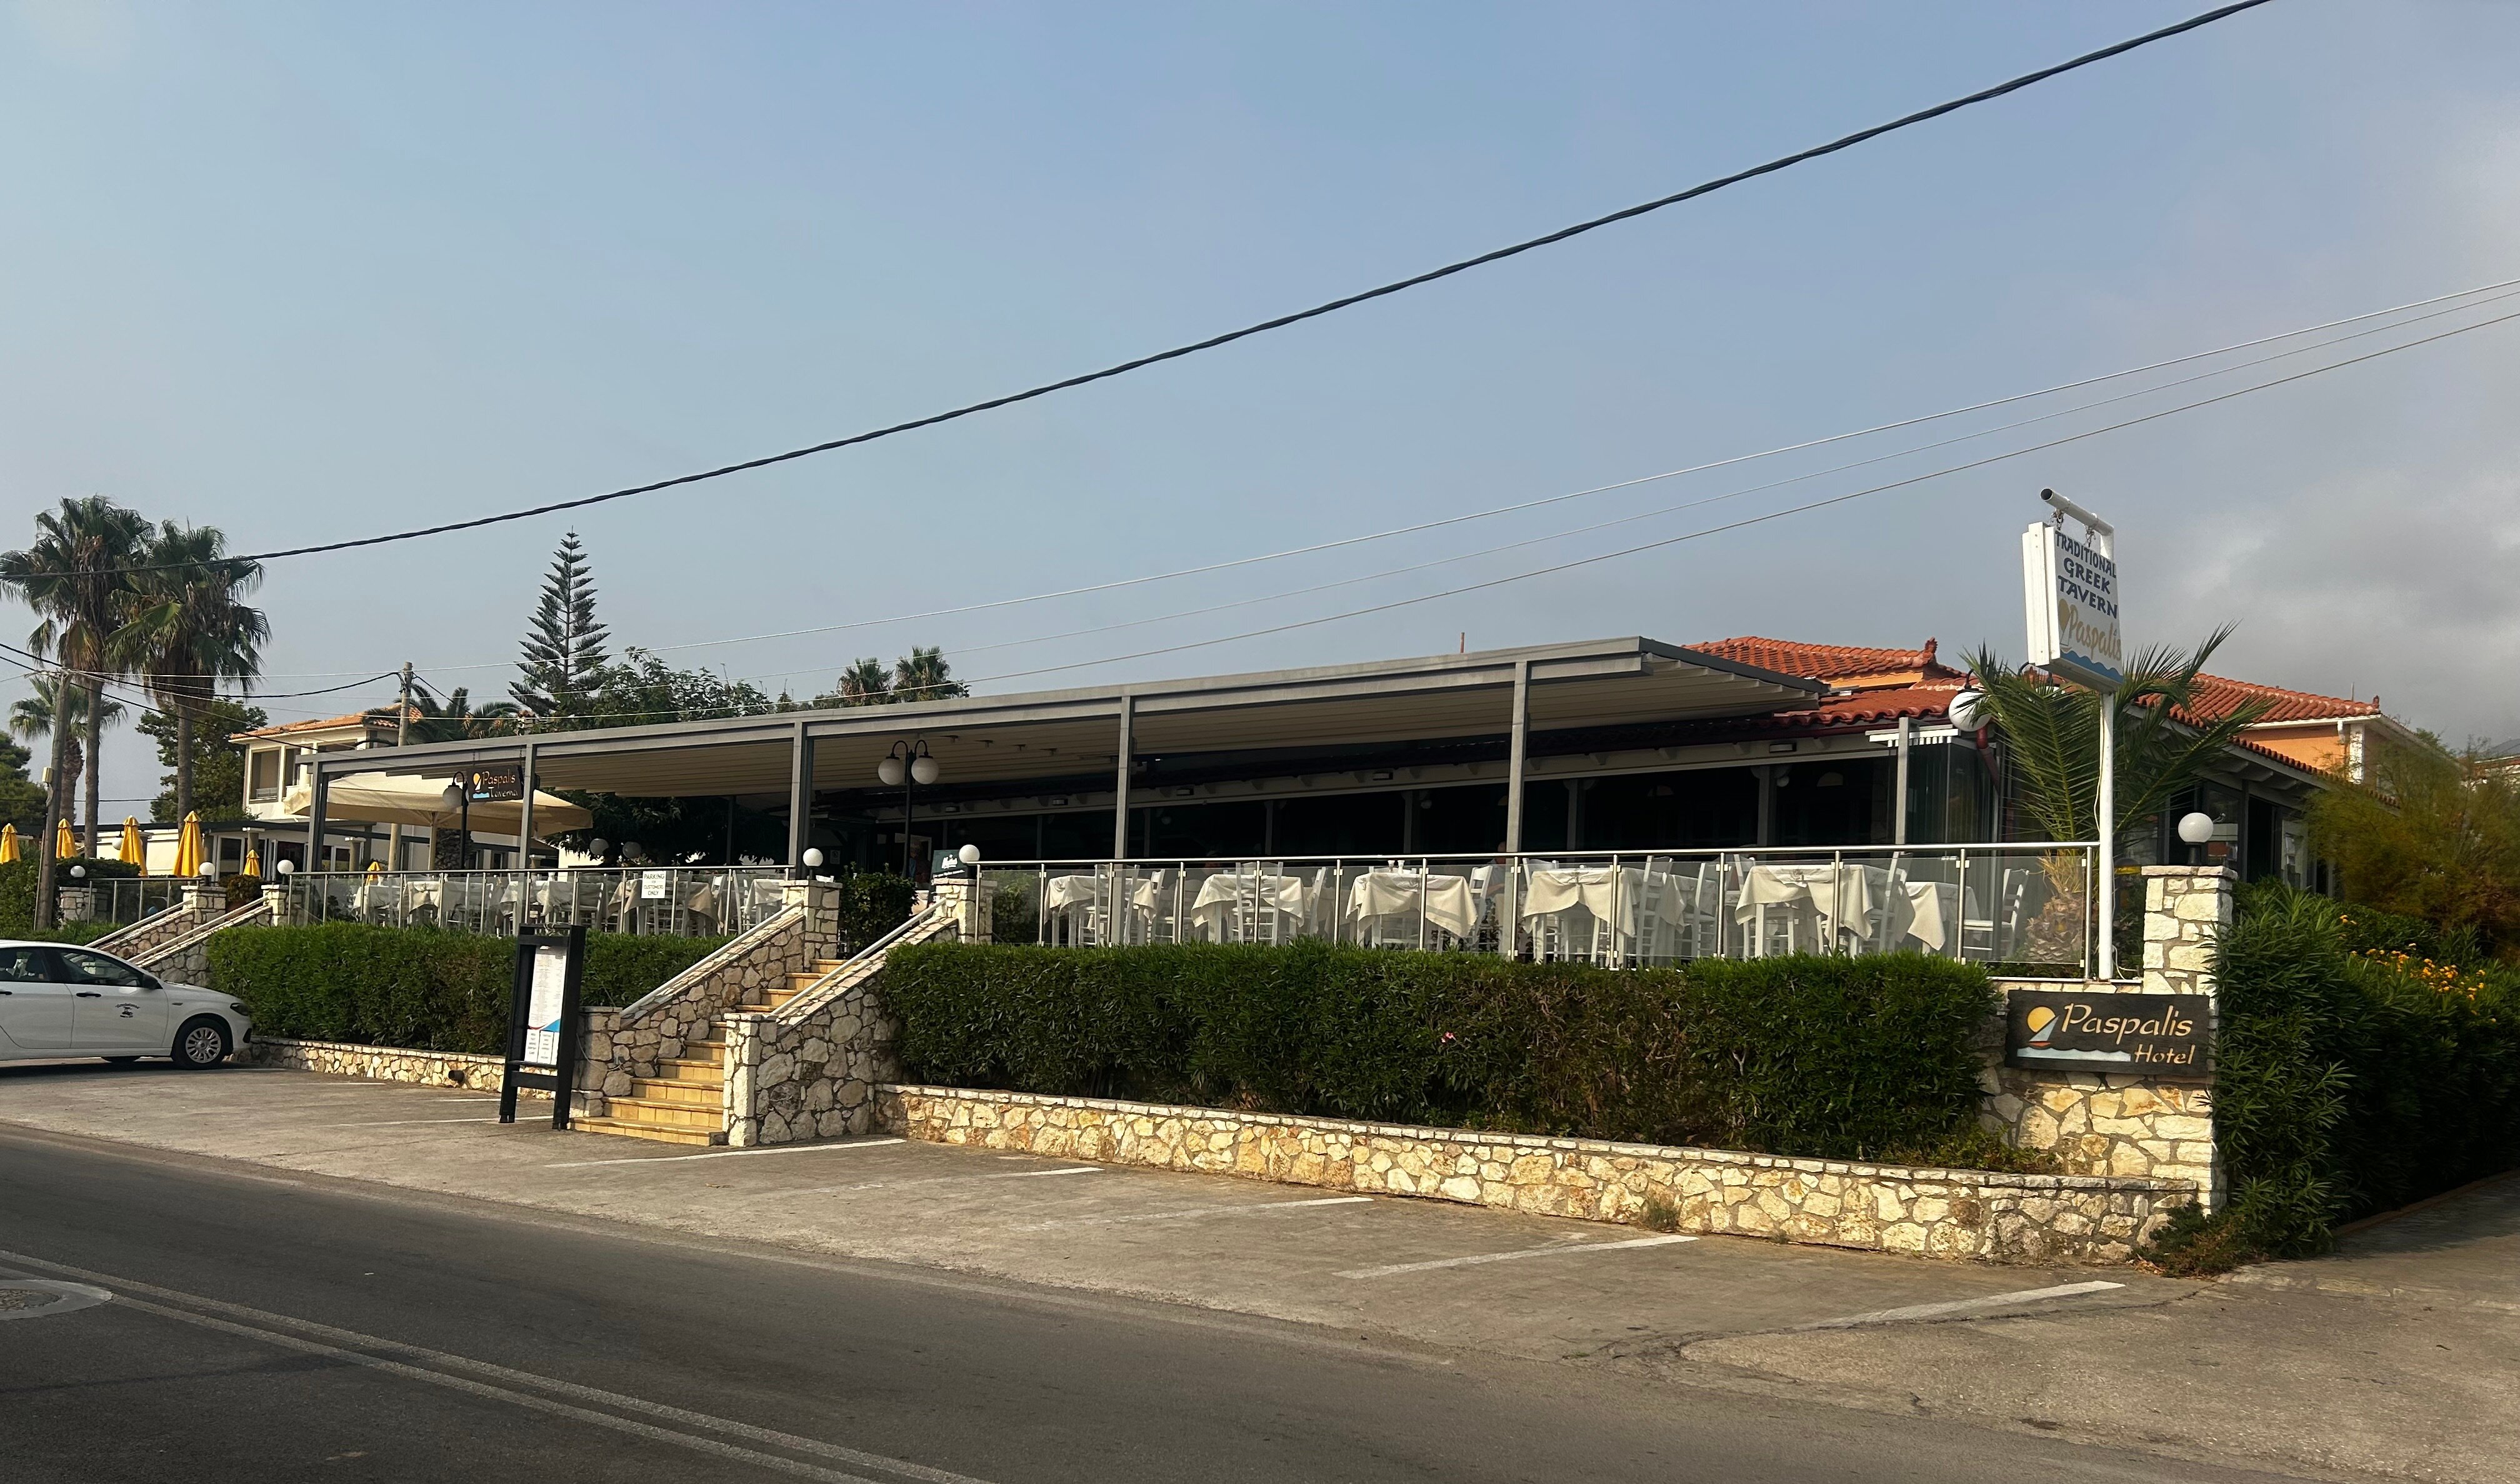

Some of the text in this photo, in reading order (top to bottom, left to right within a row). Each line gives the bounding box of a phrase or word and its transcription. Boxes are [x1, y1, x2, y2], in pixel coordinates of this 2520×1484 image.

[2055, 531, 2116, 579] TRADITIONAL
[2064, 557, 2110, 594] GREEK
[2058, 575, 2118, 619] TAVERN
[2069, 604, 2121, 661] Paspalis
[482, 768, 516, 789] Paspalis
[488, 786, 518, 798] Taverna
[2061, 1003, 2193, 1045] Paspalis
[2134, 1043, 2196, 1065] Hotel
